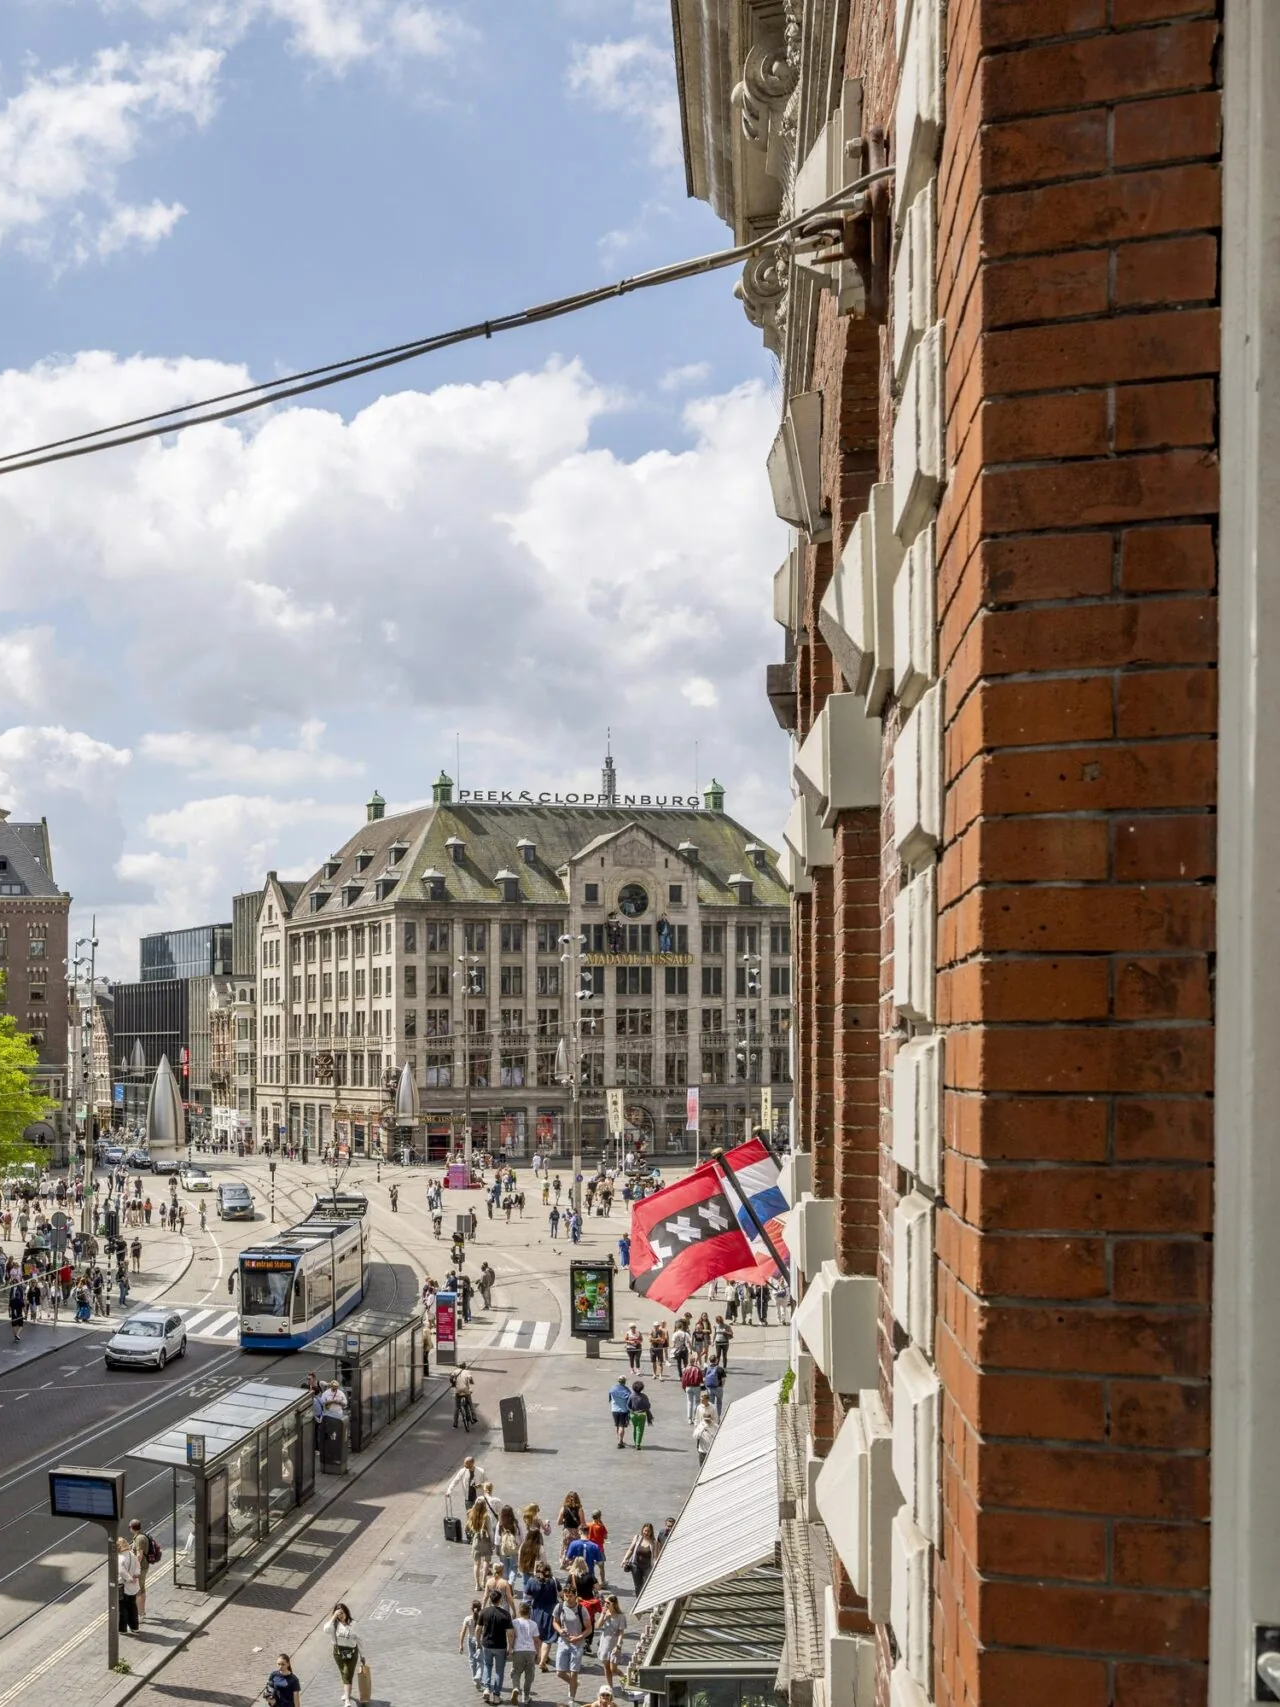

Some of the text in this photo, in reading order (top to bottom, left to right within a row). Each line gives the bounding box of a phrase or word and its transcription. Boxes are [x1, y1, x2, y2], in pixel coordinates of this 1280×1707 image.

[458, 790, 701, 806] PEEK & CLOPPENBURG
[587, 952, 641, 966] MADAME
